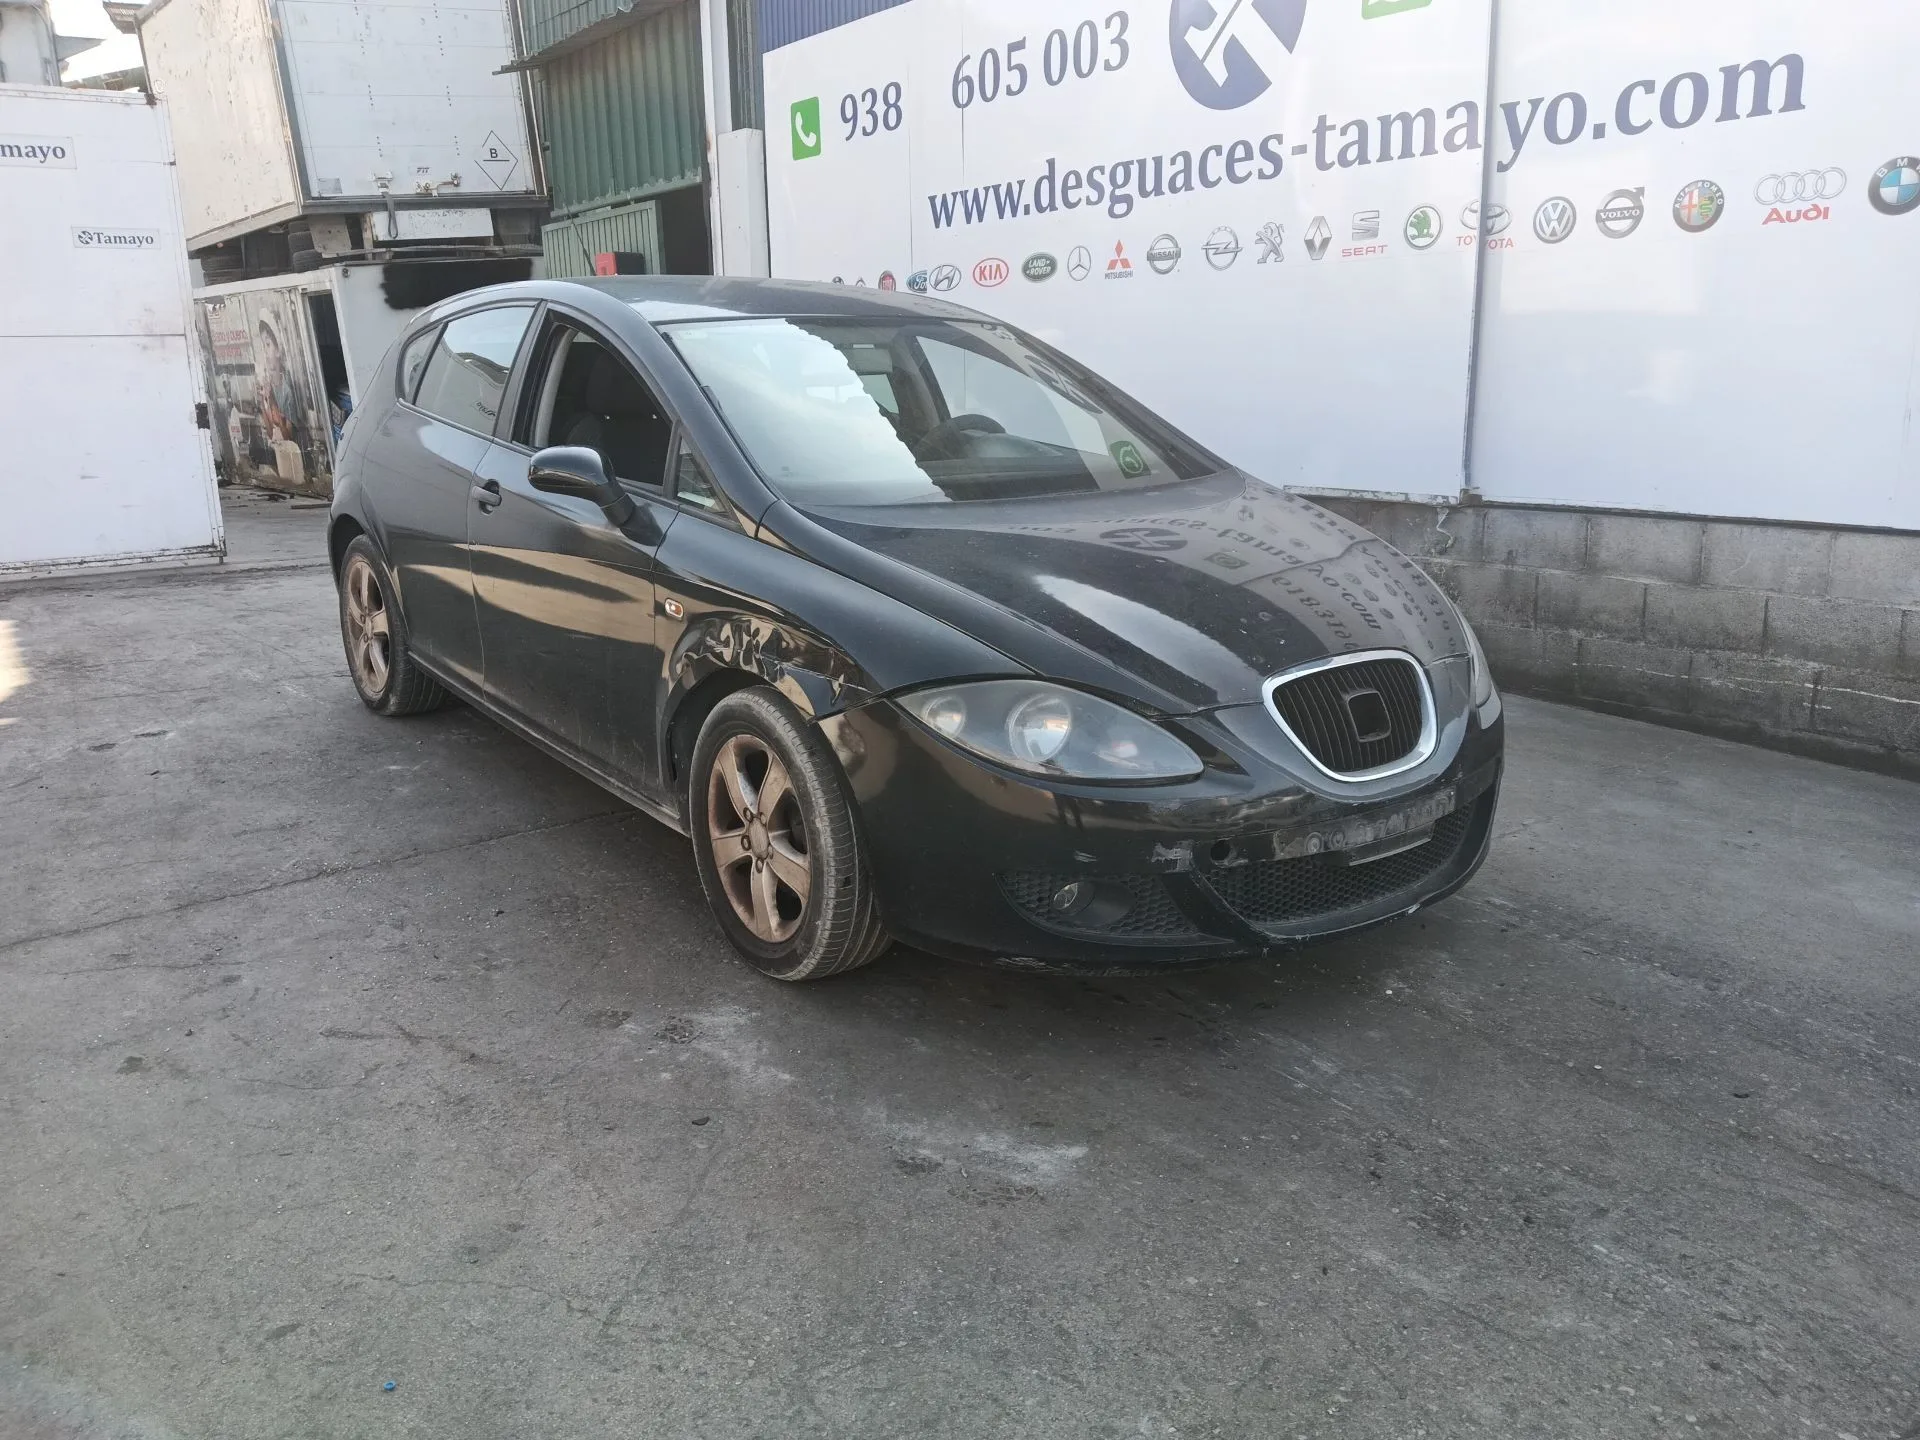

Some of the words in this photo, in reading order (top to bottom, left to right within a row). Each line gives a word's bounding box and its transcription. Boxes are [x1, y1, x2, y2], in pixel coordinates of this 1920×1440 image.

[840, 81, 903, 141] 938
[952, 37, 1029, 109] 605
[1043, 10, 1131, 87] 003
[928, 53, 1806, 229] www.desguaces-tamayo.com
[0, 143, 67, 164] mayo
[489, 147, 499, 159] B
[1600, 208, 1641, 219] VOLVO
[1761, 203, 1830, 226] Audi
[93, 231, 154, 248] Tamayo
[1150, 250, 1177, 259] NISSAN
[1341, 244, 1388, 258] SEAT
[979, 263, 1003, 282] KIA
[1104, 270, 1134, 280] MITSUBISHI
